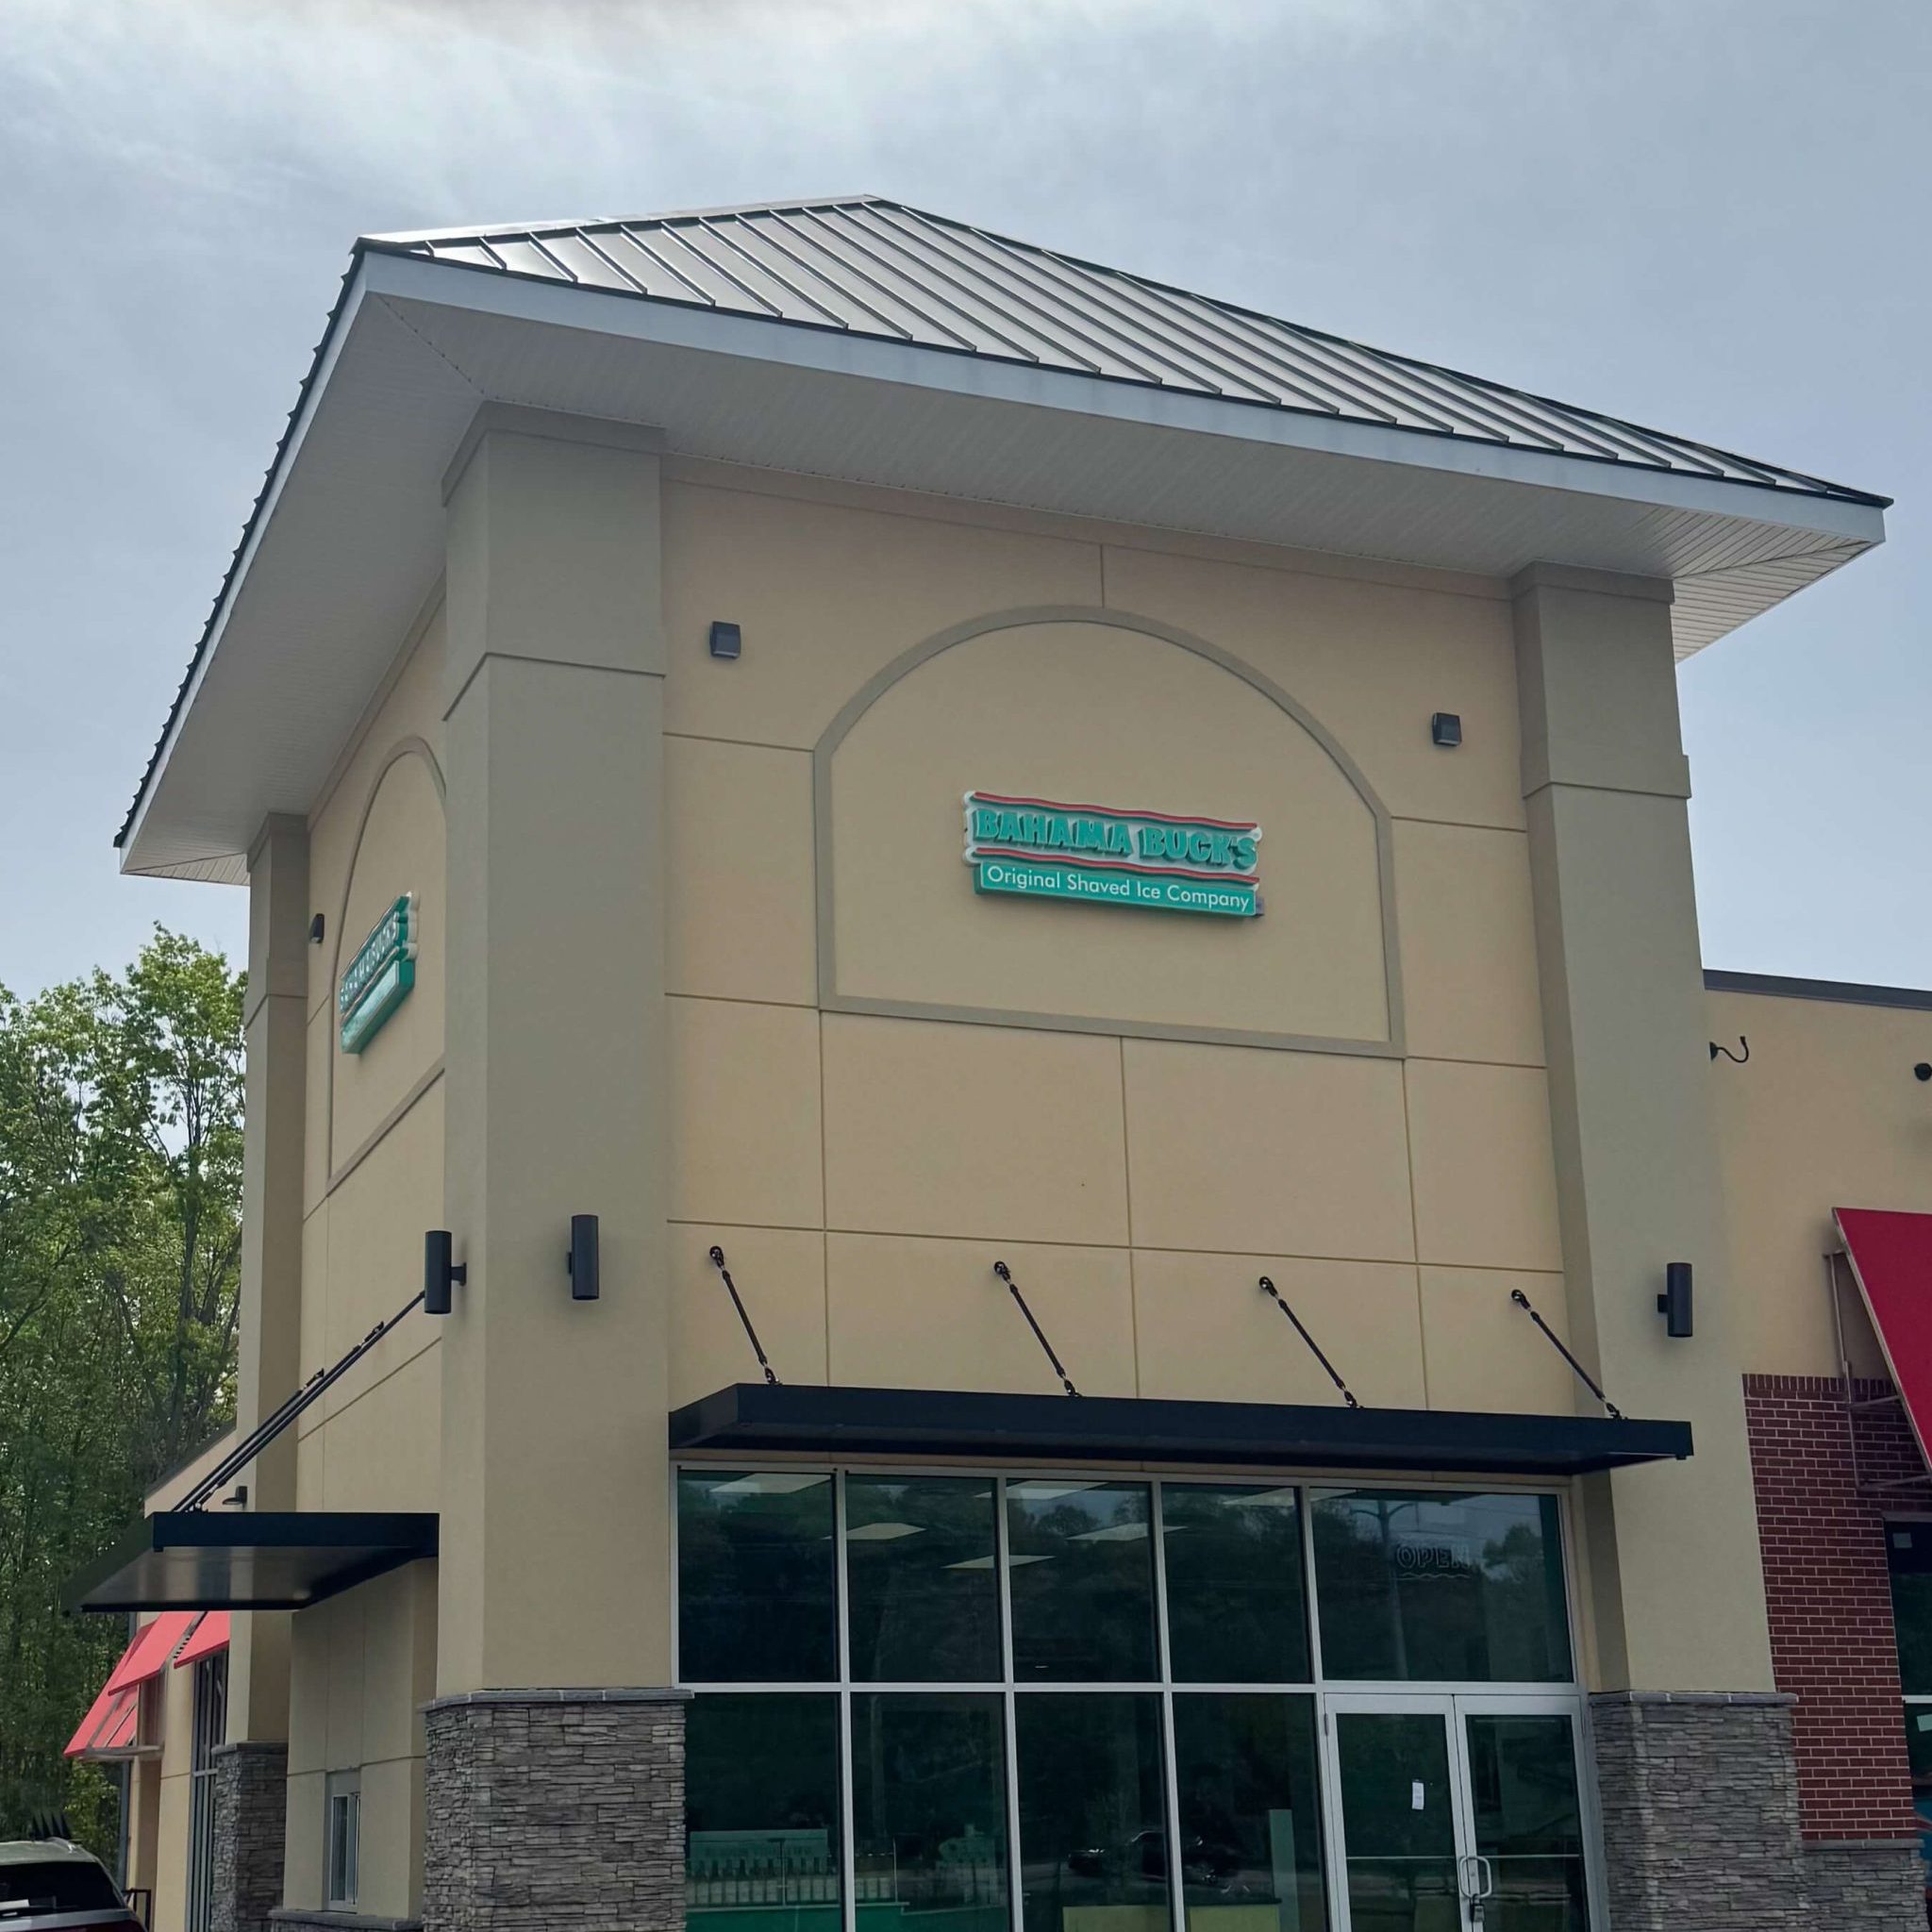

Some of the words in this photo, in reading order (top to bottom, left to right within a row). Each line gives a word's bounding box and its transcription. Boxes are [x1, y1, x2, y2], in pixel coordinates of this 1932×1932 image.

[974, 809, 1132, 856] BAHAMA
[1140, 827, 1257, 869] BUCK'S
[987, 865, 1060, 889] Original
[1067, 873, 1130, 896] Shaved
[1136, 881, 1161, 899] Ice
[1167, 885, 1250, 911] Company
[1396, 1545, 1471, 1569] OPEN
